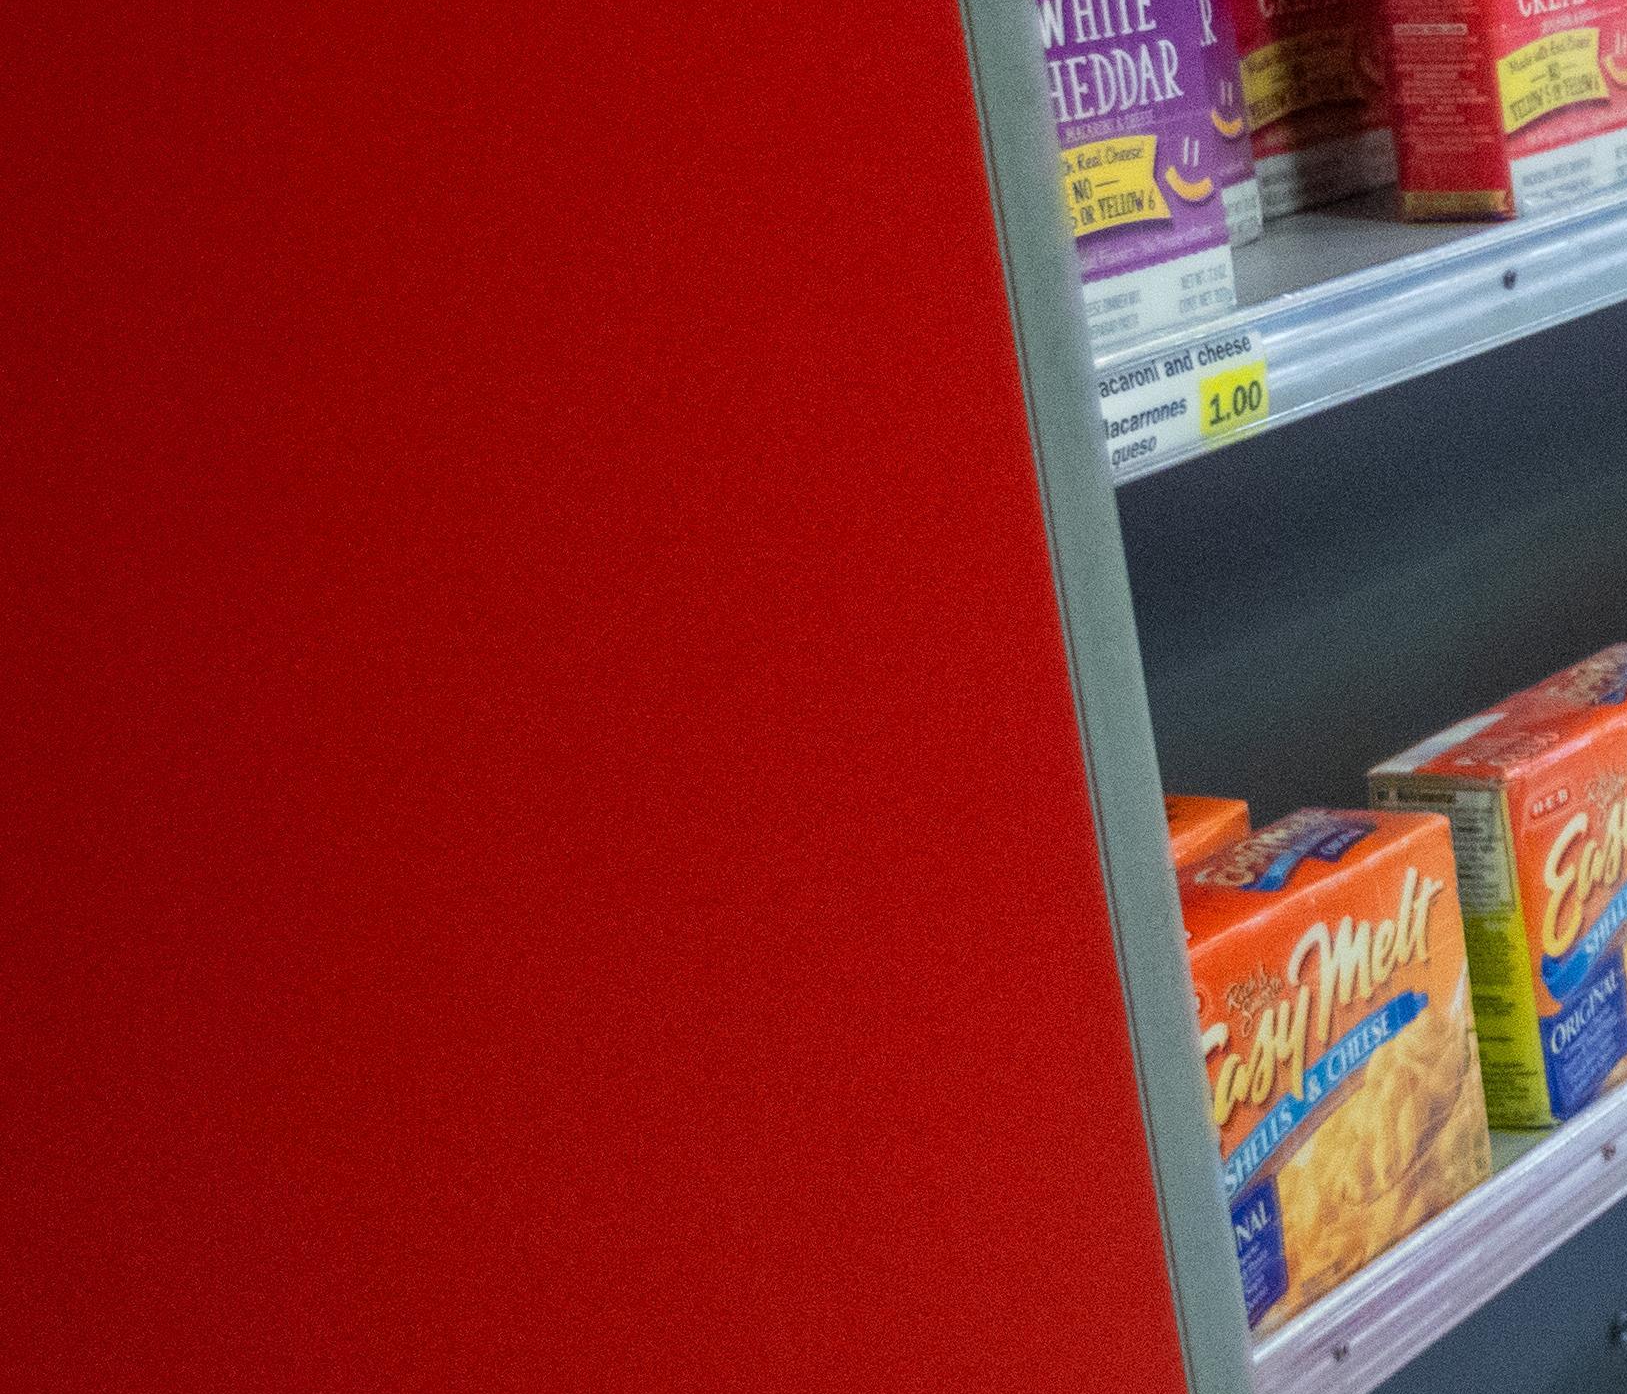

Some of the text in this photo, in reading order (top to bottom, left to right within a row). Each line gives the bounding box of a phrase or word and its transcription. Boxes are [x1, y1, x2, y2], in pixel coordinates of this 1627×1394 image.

[1046, 38, 1184, 125] HEDDAR
[1099, 335, 1252, 398] acaroni and cheese
[1103, 397, 1188, 440] acarrones
[1208, 379, 1264, 427] 1.00
[1288, 866, 1445, 1043] Melt
[1325, 1012, 1393, 1085] CHEESE
